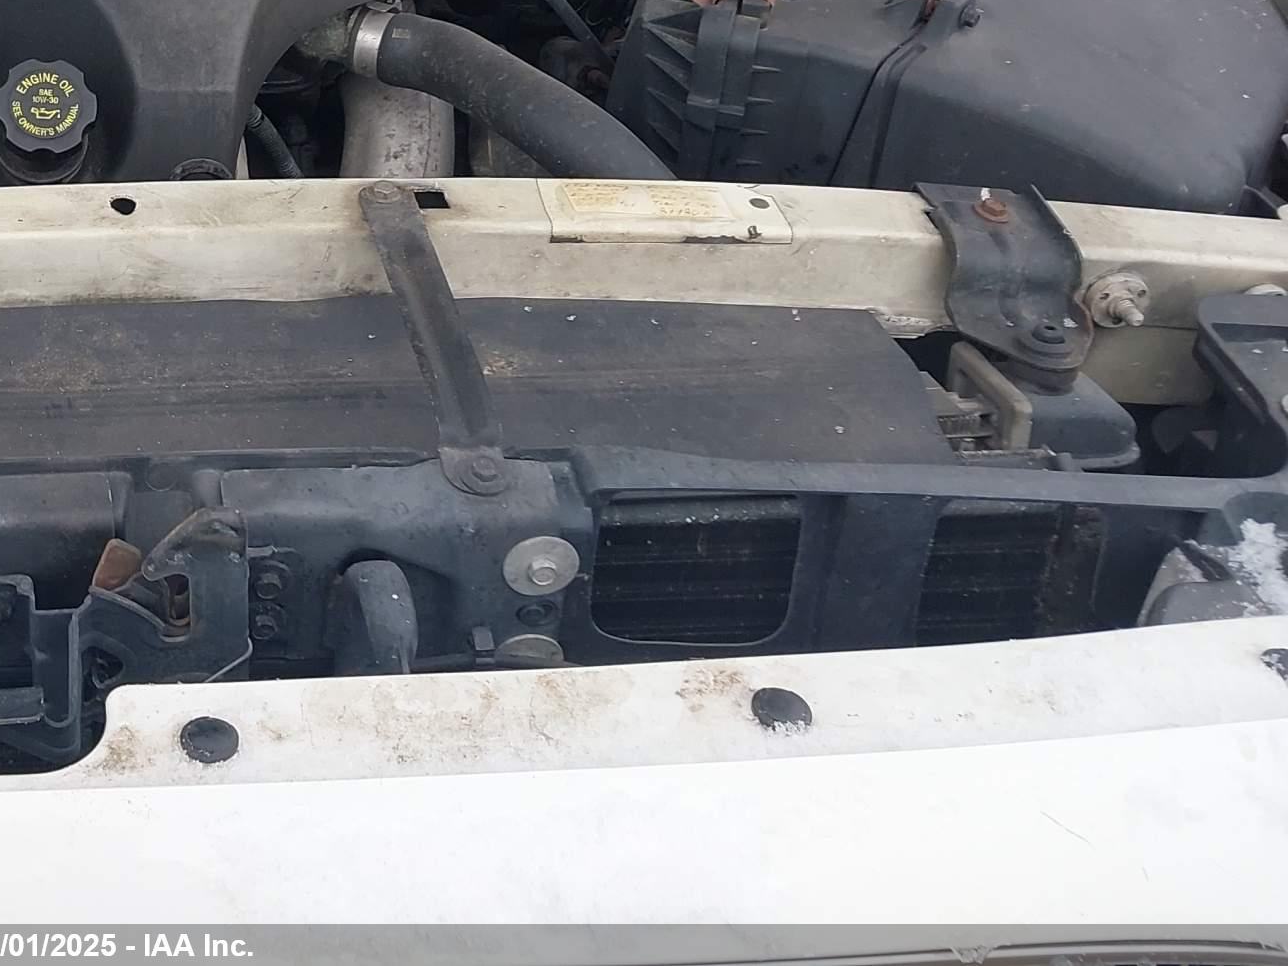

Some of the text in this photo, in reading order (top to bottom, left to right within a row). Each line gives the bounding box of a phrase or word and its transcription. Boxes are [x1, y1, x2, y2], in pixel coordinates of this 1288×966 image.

[15, 72, 75, 98] ENGINE OIL
[38, 88, 53, 96] SAE
[32, 95, 59, 104] 10W-30
[12, 100, 79, 136] SEE OWNER'S MANUAL
